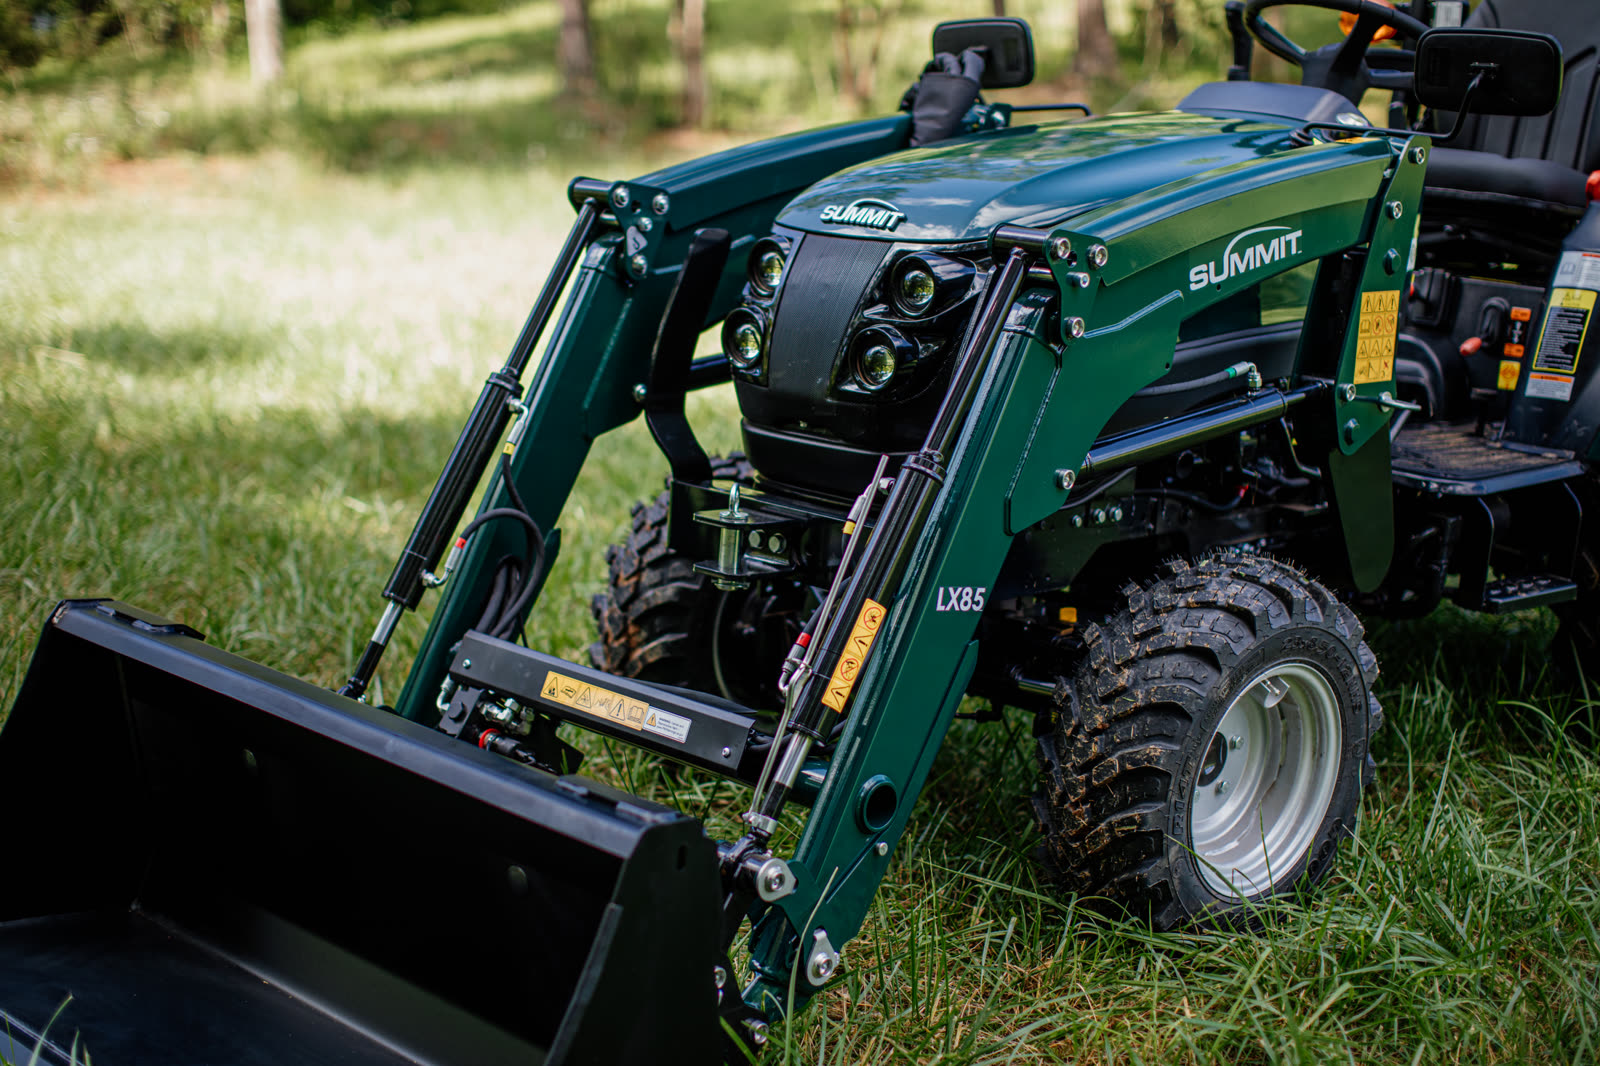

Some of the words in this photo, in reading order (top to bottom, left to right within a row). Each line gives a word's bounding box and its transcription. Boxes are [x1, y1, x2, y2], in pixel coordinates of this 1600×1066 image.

[820, 198, 905, 228] SUMMIT
[1189, 226, 1302, 291] SUMMIT
[936, 586, 986, 612] LX85
